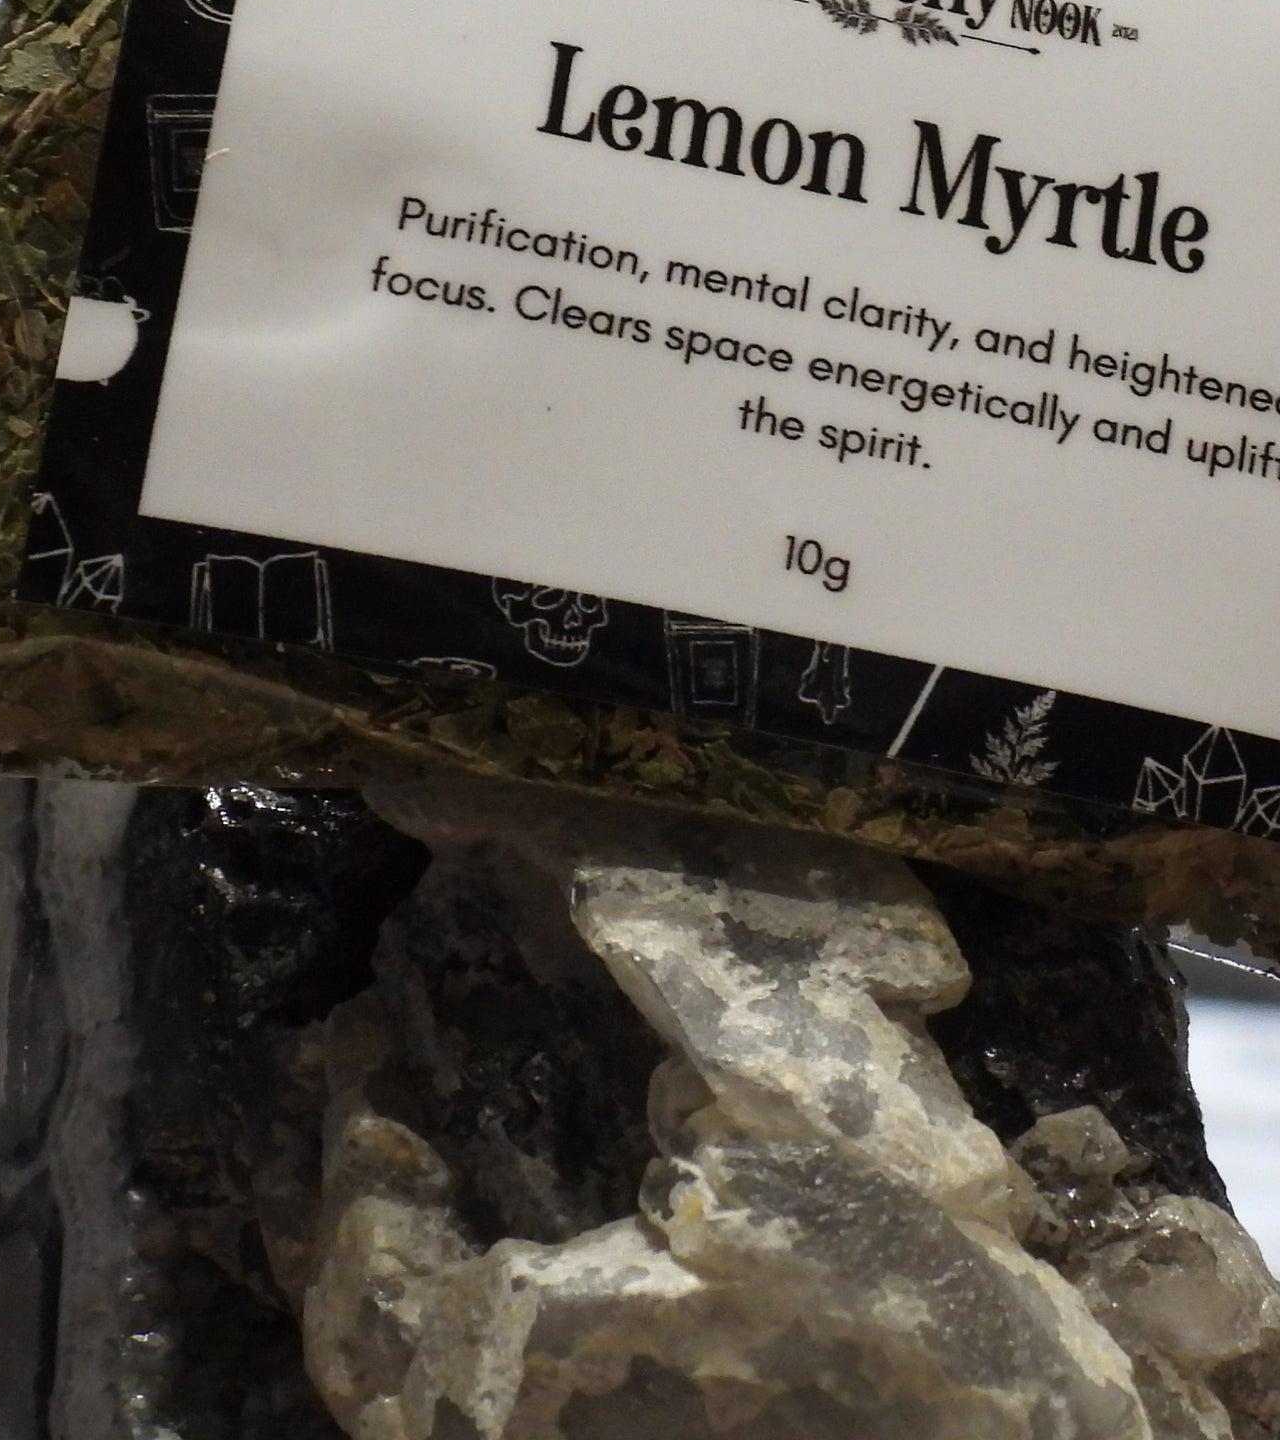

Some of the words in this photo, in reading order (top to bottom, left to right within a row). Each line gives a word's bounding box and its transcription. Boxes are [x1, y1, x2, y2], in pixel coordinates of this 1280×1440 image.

[536, 41, 868, 204] Lemon
[899, 119, 1209, 274] Myrtle
[371, 256, 497, 313] focus.
[514, 285, 653, 344] Clears
[664, 326, 794, 373] space
[807, 356, 1082, 446] energetically
[1091, 417, 1172, 456] and
[398, 196, 651, 285] Purification,
[665, 261, 811, 313] mental
[823, 296, 960, 352] clarity,
[974, 328, 1056, 366] and
[737, 395, 806, 442] the
[818, 424, 932, 471] spirit.
[784, 534, 852, 594] 10g
